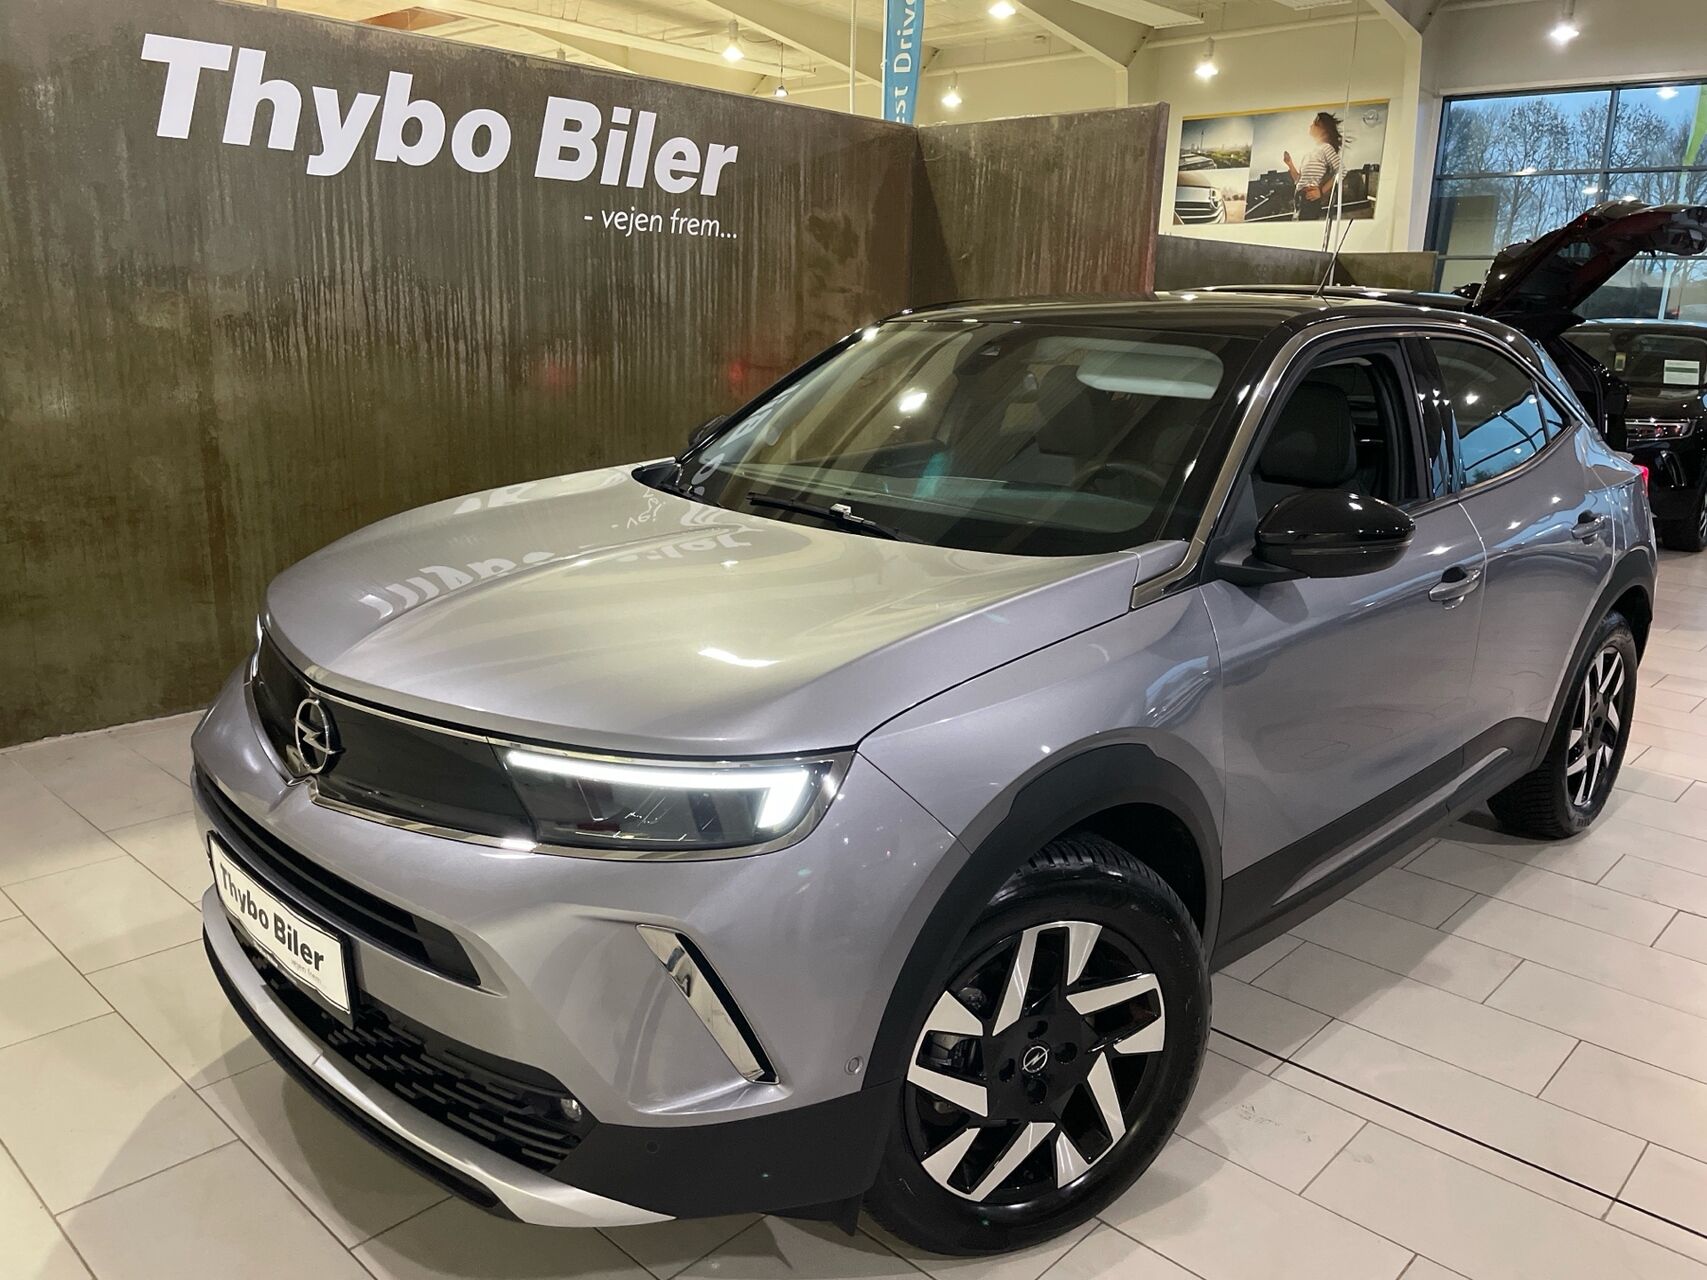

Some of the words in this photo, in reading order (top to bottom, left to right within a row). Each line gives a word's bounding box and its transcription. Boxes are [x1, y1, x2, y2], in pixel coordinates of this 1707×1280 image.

[141, 33, 511, 177] Thybo
[534, 96, 739, 197] Biler
[601, 206, 663, 237] vejen
[670, 207, 737, 239] frem...
[219, 863, 270, 930] Thybo
[273, 912, 325, 971] Biler
